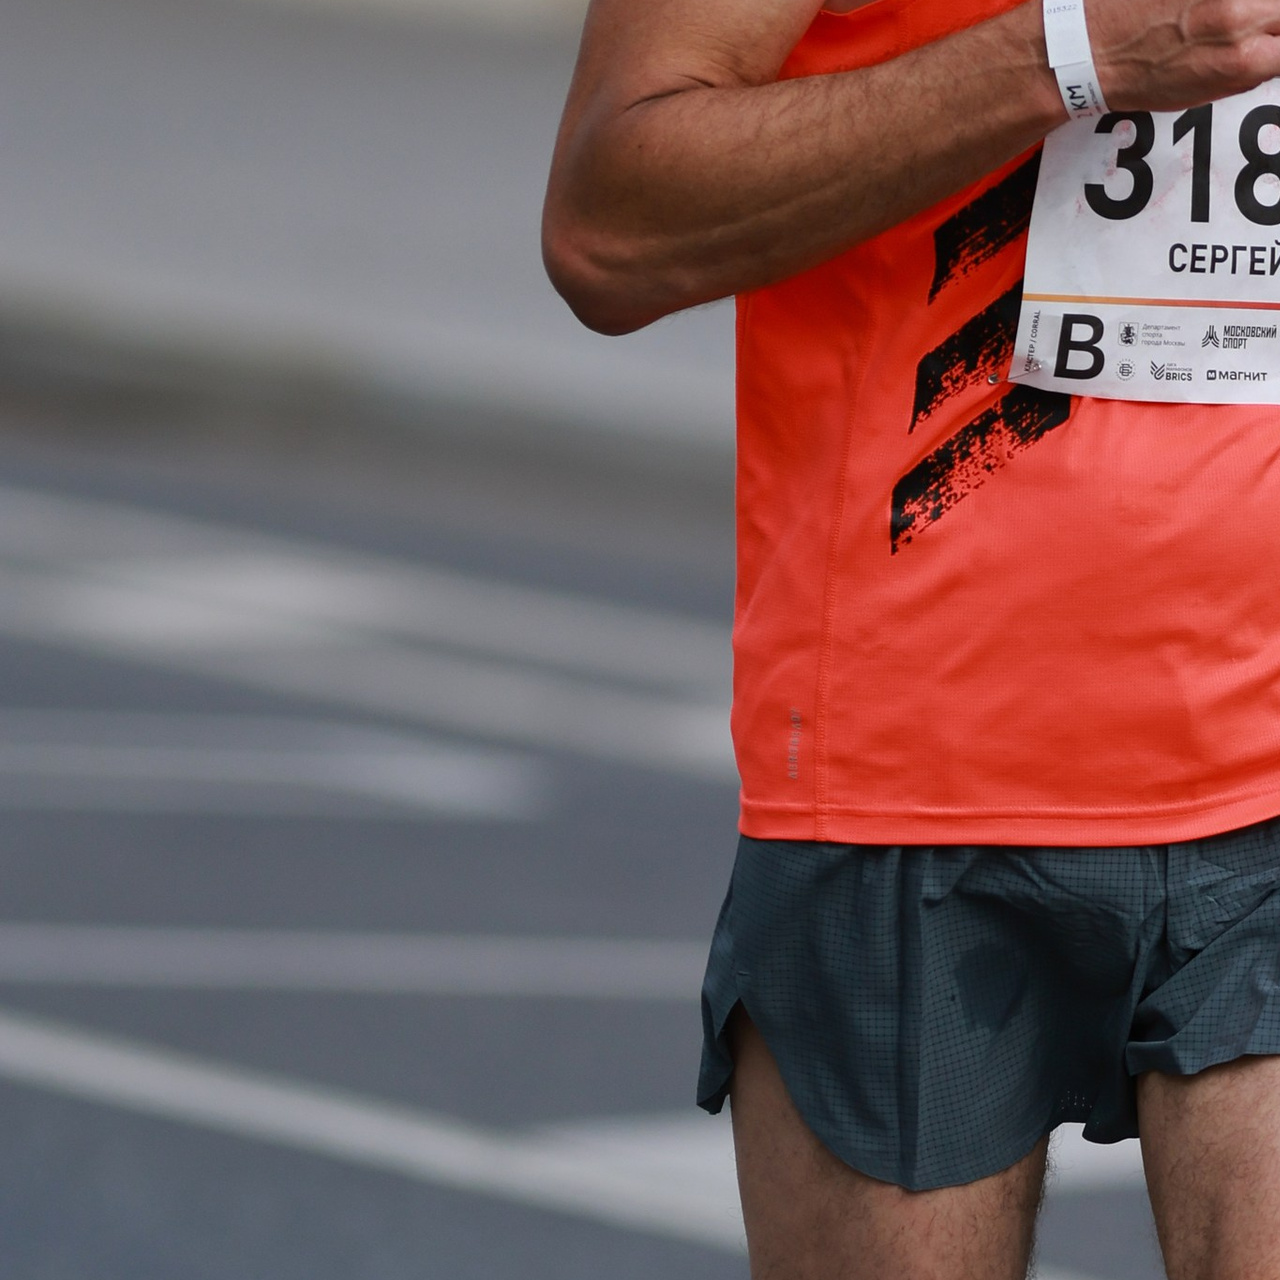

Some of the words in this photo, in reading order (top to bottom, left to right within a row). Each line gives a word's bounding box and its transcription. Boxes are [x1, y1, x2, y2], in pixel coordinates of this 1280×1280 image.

[1030, 309, 1041, 339] CORRAL
[1223, 324, 1277, 339] МОСКОВСКИЙ
[1222, 337, 1248, 349] СПОРТ
[1165, 372, 1193, 381] BRICS
